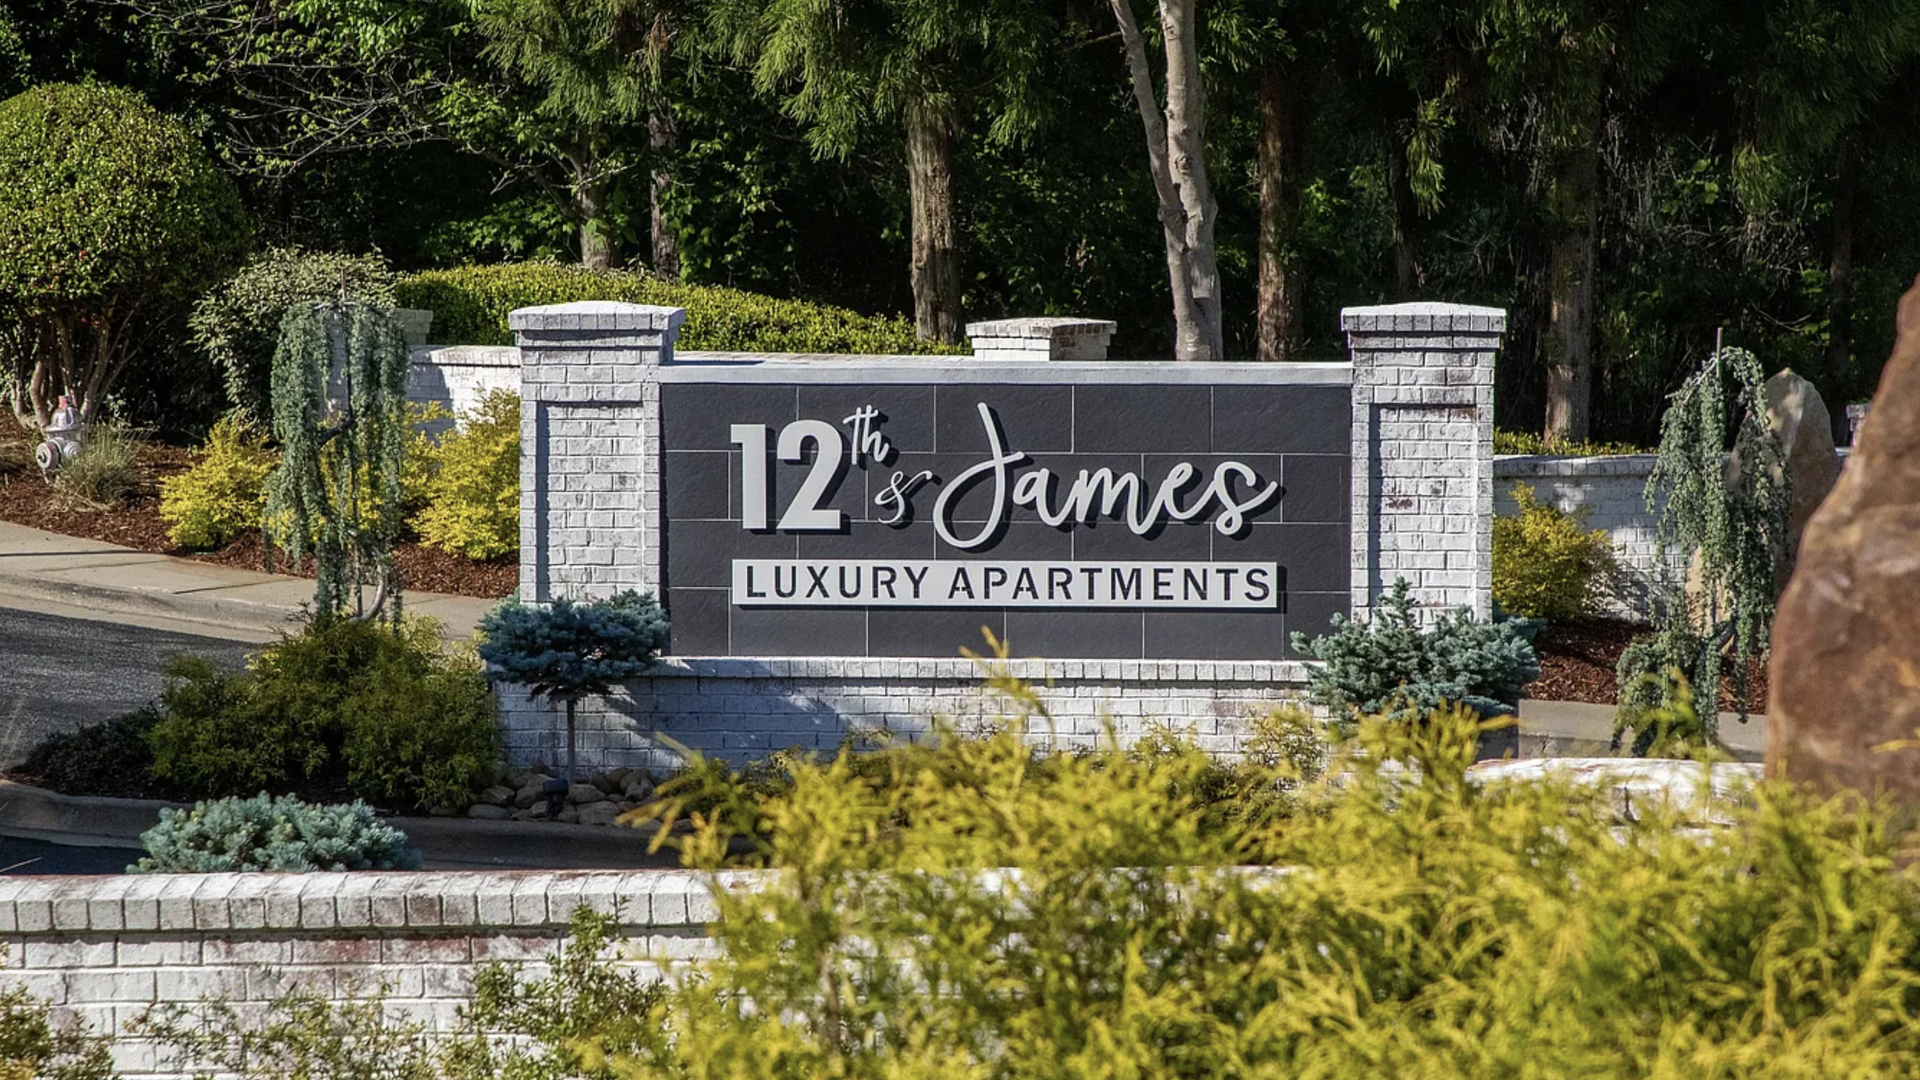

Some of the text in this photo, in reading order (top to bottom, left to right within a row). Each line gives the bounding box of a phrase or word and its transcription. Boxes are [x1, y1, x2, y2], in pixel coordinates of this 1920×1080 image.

[730, 402, 1278, 548] 12th & James
[745, 565, 1271, 602] LUXURY APARTMENTS
